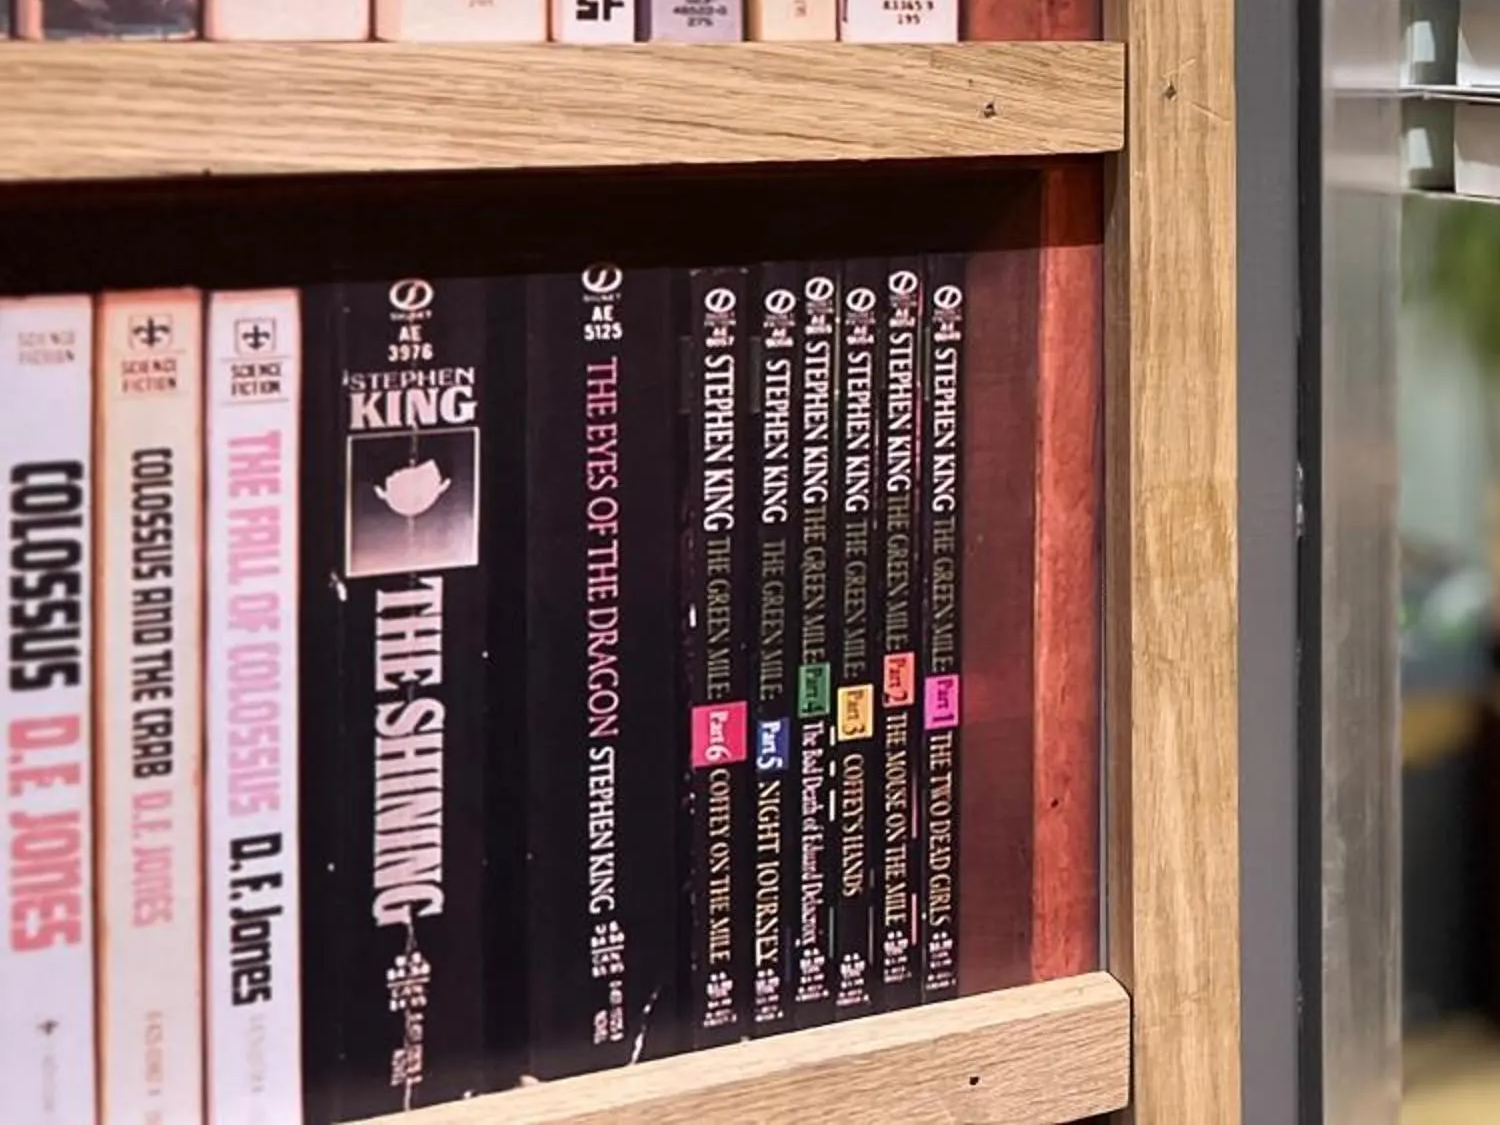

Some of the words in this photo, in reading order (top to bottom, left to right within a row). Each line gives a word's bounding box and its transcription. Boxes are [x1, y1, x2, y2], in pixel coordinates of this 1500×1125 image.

[398, 325, 422, 342] AE
[583, 321, 623, 342] 5125
[592, 304, 614, 322] AE
[349, 366, 476, 391] STEPHEN
[388, 343, 434, 363] 3976
[888, 331, 913, 430] STEPHEN
[349, 386, 478, 430] KING
[586, 355, 618, 419] THE
[703, 354, 735, 463] STEPHEN
[763, 359, 791, 460] STEPHEN
[804, 341, 830, 441] STEPHEN
[846, 351, 872, 450] STEPHEN
[932, 347, 957, 450] STEPHEN
[227, 430, 282, 499] THE
[586, 422, 617, 492] EYES
[803, 445, 829, 504] KING
[845, 454, 869, 513] KING
[887, 434, 912, 493] KING
[932, 454, 956, 513] KING
[131, 447, 173, 581] COLOSSUS
[586, 496, 619, 536] OF
[703, 467, 735, 532] KING
[761, 465, 789, 524] KING
[887, 492, 910, 532] THE
[227, 504, 281, 585] FALL
[803, 505, 826, 544] THE
[845, 519, 868, 557] THE
[933, 515, 955, 555] THE
[9, 459, 84, 692] COLOSSUS
[587, 538, 619, 603] THE
[706, 535, 731, 575] THE
[762, 538, 786, 577] THE
[802, 546, 826, 611] GREEN
[886, 534, 910, 597] GREEN
[131, 585, 173, 646] AND
[227, 592, 281, 633] OF
[706, 578, 731, 643] GREEN
[761, 580, 785, 645] GREEN
[844, 560, 867, 624] GREEN
[932, 557, 955, 622] GREEN
[375, 576, 443, 692] THE
[131, 648, 173, 703] THE
[587, 606, 620, 739] DRAGON
[884, 689, 908, 705] 2
[888, 657, 907, 689] Part
[936, 678, 954, 711] Part
[227, 641, 281, 819] COLOSSUS
[708, 710, 728, 744] Part
[801, 720, 824, 746] The
[842, 722, 865, 736] 3
[845, 689, 864, 721] Part
[885, 711, 908, 749] THE
[931, 713, 955, 724] 1
[131, 706, 173, 779] CRAB
[704, 743, 732, 762] 6
[756, 754, 783, 771] 5
[760, 719, 782, 754] Part
[929, 730, 953, 771] THE
[588, 745, 615, 851] STEPHEN
[708, 768, 731, 838] COFFEY
[885, 750, 907, 812] MOUSE
[929, 771, 952, 818] TWO
[372, 697, 446, 928] SHINING
[757, 779, 781, 854] NIGHT
[885, 812, 907, 842] ON
[708, 841, 731, 874] ON
[842, 834, 864, 897] HANDS
[885, 843, 907, 882] THE
[928, 818, 951, 873] DEAD
[8, 810, 82, 953] JONES
[131, 845, 174, 928] JONES
[588, 851, 615, 915] KING
[708, 875, 731, 915] THE
[884, 882, 906, 927] MILE
[928, 873, 951, 928] GIRLS
[228, 904, 284, 1007] Jones
[708, 916, 731, 965] MILE
